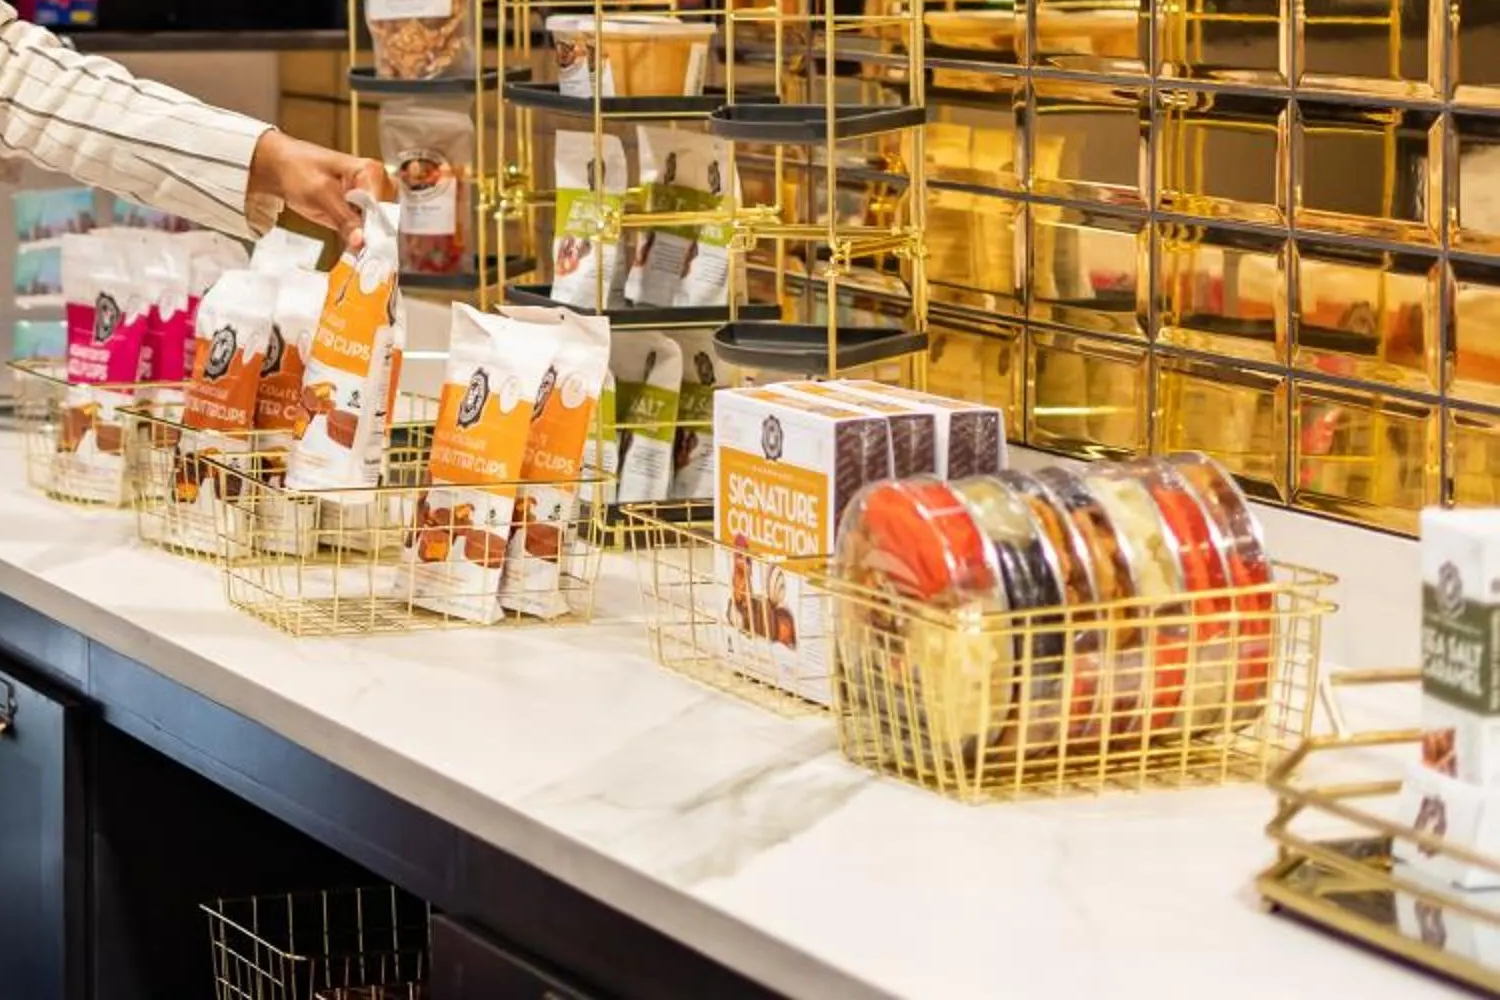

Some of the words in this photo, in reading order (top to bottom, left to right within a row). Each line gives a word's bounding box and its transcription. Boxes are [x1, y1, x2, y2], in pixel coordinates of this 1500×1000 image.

[534, 450, 575, 476] CUPS
[728, 471, 819, 529] SIGNATURE
[727, 507, 820, 556] COLLECTION
